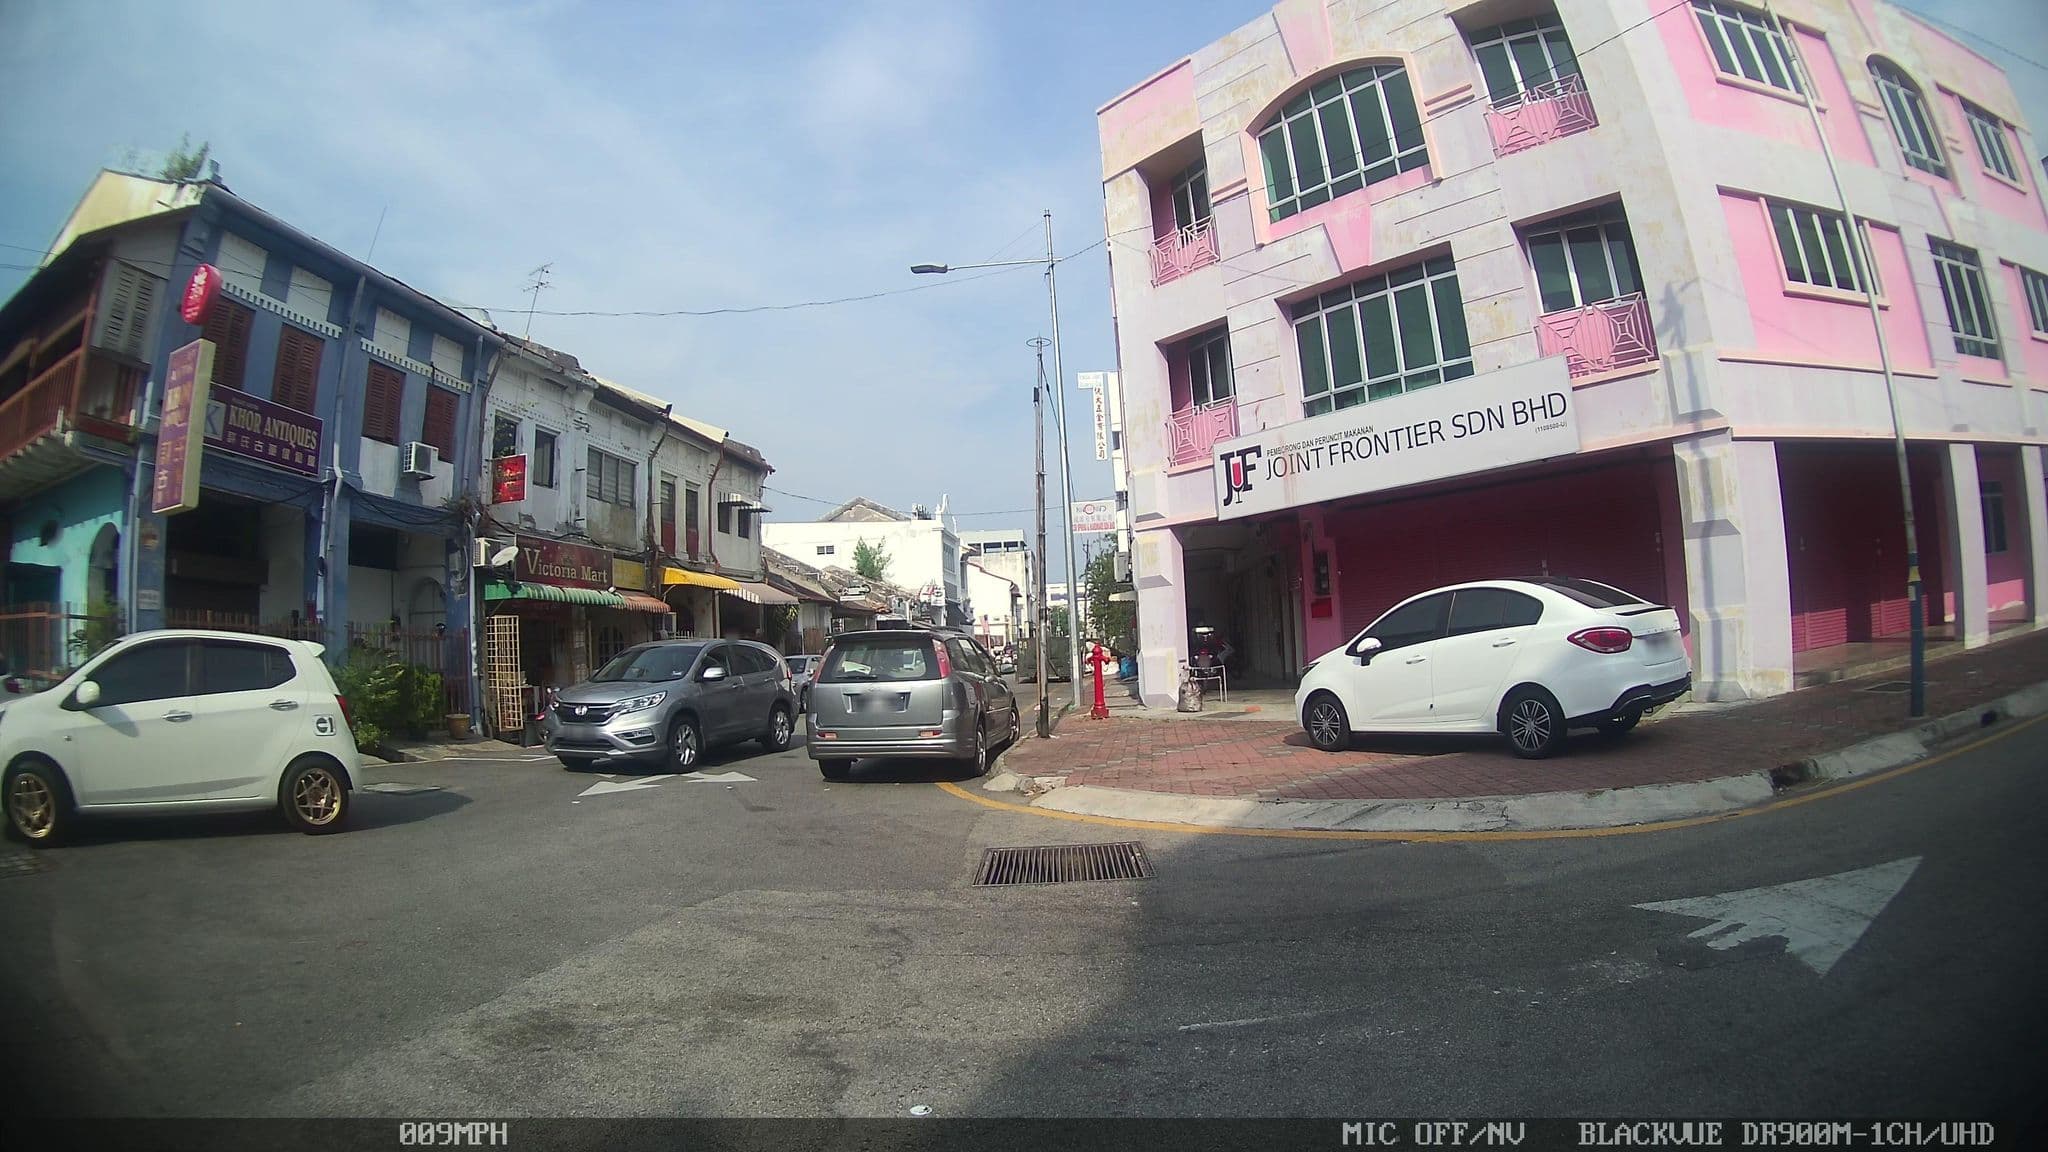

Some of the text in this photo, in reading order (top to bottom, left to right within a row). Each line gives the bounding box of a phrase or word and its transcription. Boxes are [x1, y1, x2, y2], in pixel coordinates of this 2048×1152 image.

[228, 404, 262, 434] KHOR
[263, 416, 318, 450] ANTIQUES
[1266, 392, 1567, 481] JOINT FRONTIER SDN BHD
[1266, 425, 1374, 456] PEMBORONG DAN PERUNCIT MAKANAN
[524, 547, 608, 583] Victoria Mart
